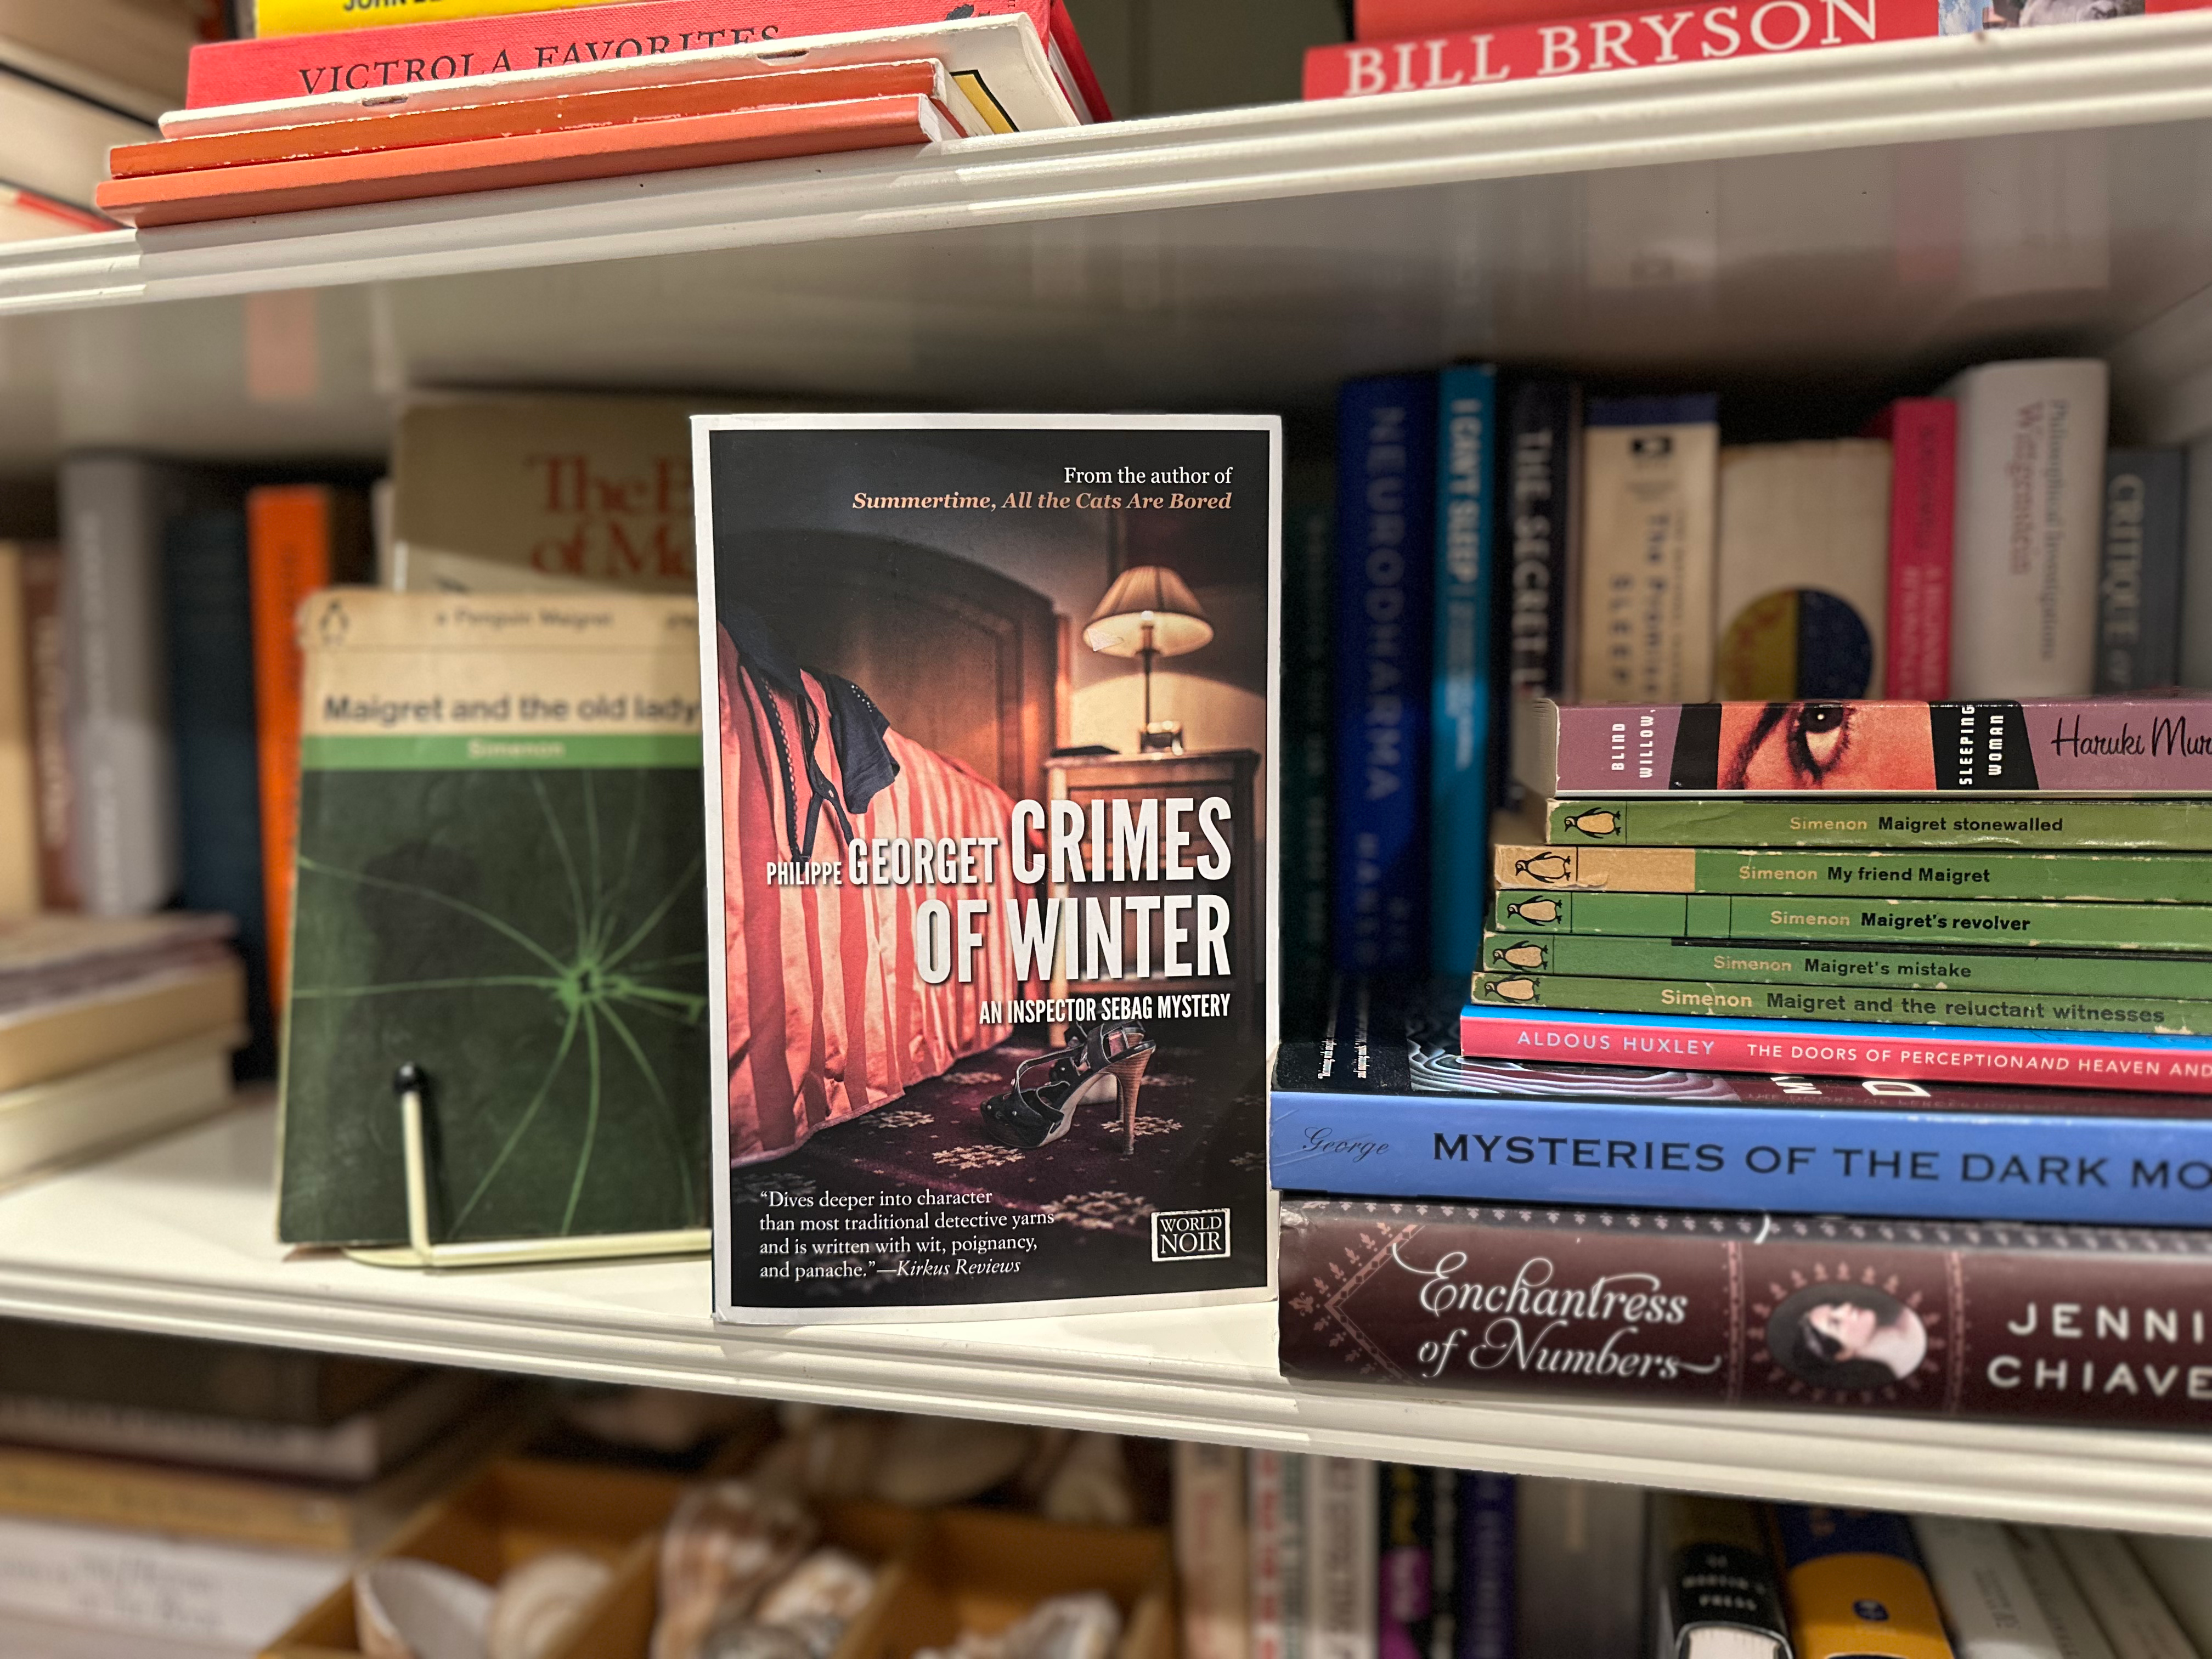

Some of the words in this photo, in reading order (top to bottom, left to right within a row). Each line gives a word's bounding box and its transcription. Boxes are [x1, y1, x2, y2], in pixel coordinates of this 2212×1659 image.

[299, 49, 512, 94] VICTROLA
[535, 25, 780, 68] FAVORITES
[1344, 34, 1510, 97] BILL
[1537, 0, 1876, 75] BRYSON
[1064, 467, 1112, 483] From
[1118, 467, 1146, 484] the
[1150, 466, 1211, 484] author
[1214, 466, 1233, 484] of
[852, 492, 997, 511] Summertime,
[1001, 492, 1031, 509] All
[1038, 492, 1070, 509] the
[1076, 493, 1121, 510] Cats
[1126, 493, 1164, 510] Are
[1169, 492, 1232, 510] Bored
[324, 694, 443, 725] Maigret
[451, 695, 512, 720] and
[518, 695, 568, 720] the
[577, 695, 628, 720] old
[633, 695, 701, 727] lady
[467, 740, 566, 760] Simenon
[1611, 723, 1626, 771] BLIND
[1639, 709, 1656, 779] WILLOW,
[1959, 705, 1975, 785] SLEEPING
[1988, 715, 2004, 776] WOMAN
[2051, 714, 2145, 758] Haruki
[1012, 797, 1232, 884] CRIMES
[1790, 817, 1867, 831] Simenon
[1878, 817, 1946, 833] Maigret
[1953, 818, 2063, 831] stonewalled
[767, 862, 842, 885] PHILIPPE
[849, 837, 998, 885] GEORGET
[1739, 866, 1818, 881] Simenon
[1827, 867, 1852, 883] My
[1858, 867, 1912, 881] friend
[1918, 868, 1990, 885] Maigret
[917, 899, 988, 983] OF
[1005, 894, 1231, 981] WINTER
[1770, 911, 1850, 927] Simenon
[1861, 912, 1948, 932] Maigret's
[1952, 916, 2031, 931] revolver
[1713, 956, 1791, 972] Simenon
[1804, 958, 1891, 978] Maigret's
[1897, 963, 1972, 978] mistake
[979, 1001, 1002, 1025] AN
[1007, 998, 1096, 1024] INSPECTOR
[1101, 996, 1153, 1020] SEBAG
[1158, 994, 1231, 1019] MYSTERY
[1661, 990, 1752, 1007] Simenon
[1766, 992, 1846, 1014] Maigret
[1854, 998, 1893, 1013] and
[1901, 998, 1936, 1015] the
[1945, 1001, 2044, 1019] reluctant
[2053, 1005, 2165, 1023] witnesses
[1517, 1031, 1611, 1050] ALDOUS
[1623, 1036, 1715, 1056] HUXLEY
[1747, 1043, 1782, 1058] THE
[1791, 1045, 1857, 1060] DOORS
[1866, 1048, 1891, 1062] OF
[2079, 1058, 2160, 1075] HEAVEN
[2169, 1063, 2212, 1077] AND
[1302, 1126, 1390, 1163] George
[1433, 1132, 1725, 1172] MYSTERIES
[1746, 1145, 1816, 1175] OF
[1833, 1148, 1940, 1180] THE
[1961, 1153, 2109, 1187] DARK
[760, 1190, 815, 1208] “Dives
[819, 1192, 875, 1211] deeper
[881, 1192, 912, 1206] into
[917, 1189, 992, 1205] character
[760, 1214, 795, 1232] than
[800, 1216, 839, 1231] most
[844, 1213, 929, 1230] traditional
[934, 1211, 1007, 1228] detective
[1012, 1212, 1054, 1227] yarns
[1160, 1216, 1222, 1233] WORLD
[760, 1238, 790, 1254] and
[794, 1239, 807, 1254] is
[811, 1237, 871, 1254] written
[875, 1237, 911, 1253] with
[916, 1237, 946, 1255] wit,
[951, 1235, 1037, 1254] poignancy,
[1160, 1232, 1221, 1254] NOIR
[760, 1262, 791, 1278] and
[955, 1258, 1021, 1275] Reviews
[1392, 1243, 1688, 1324] Enchantress
[2007, 1301, 2204, 1345] JENNI
[1418, 1329, 1468, 1378] of
[1470, 1318, 1721, 1379] Numbers
[1987, 1355, 2212, 1401] CHIAVE
